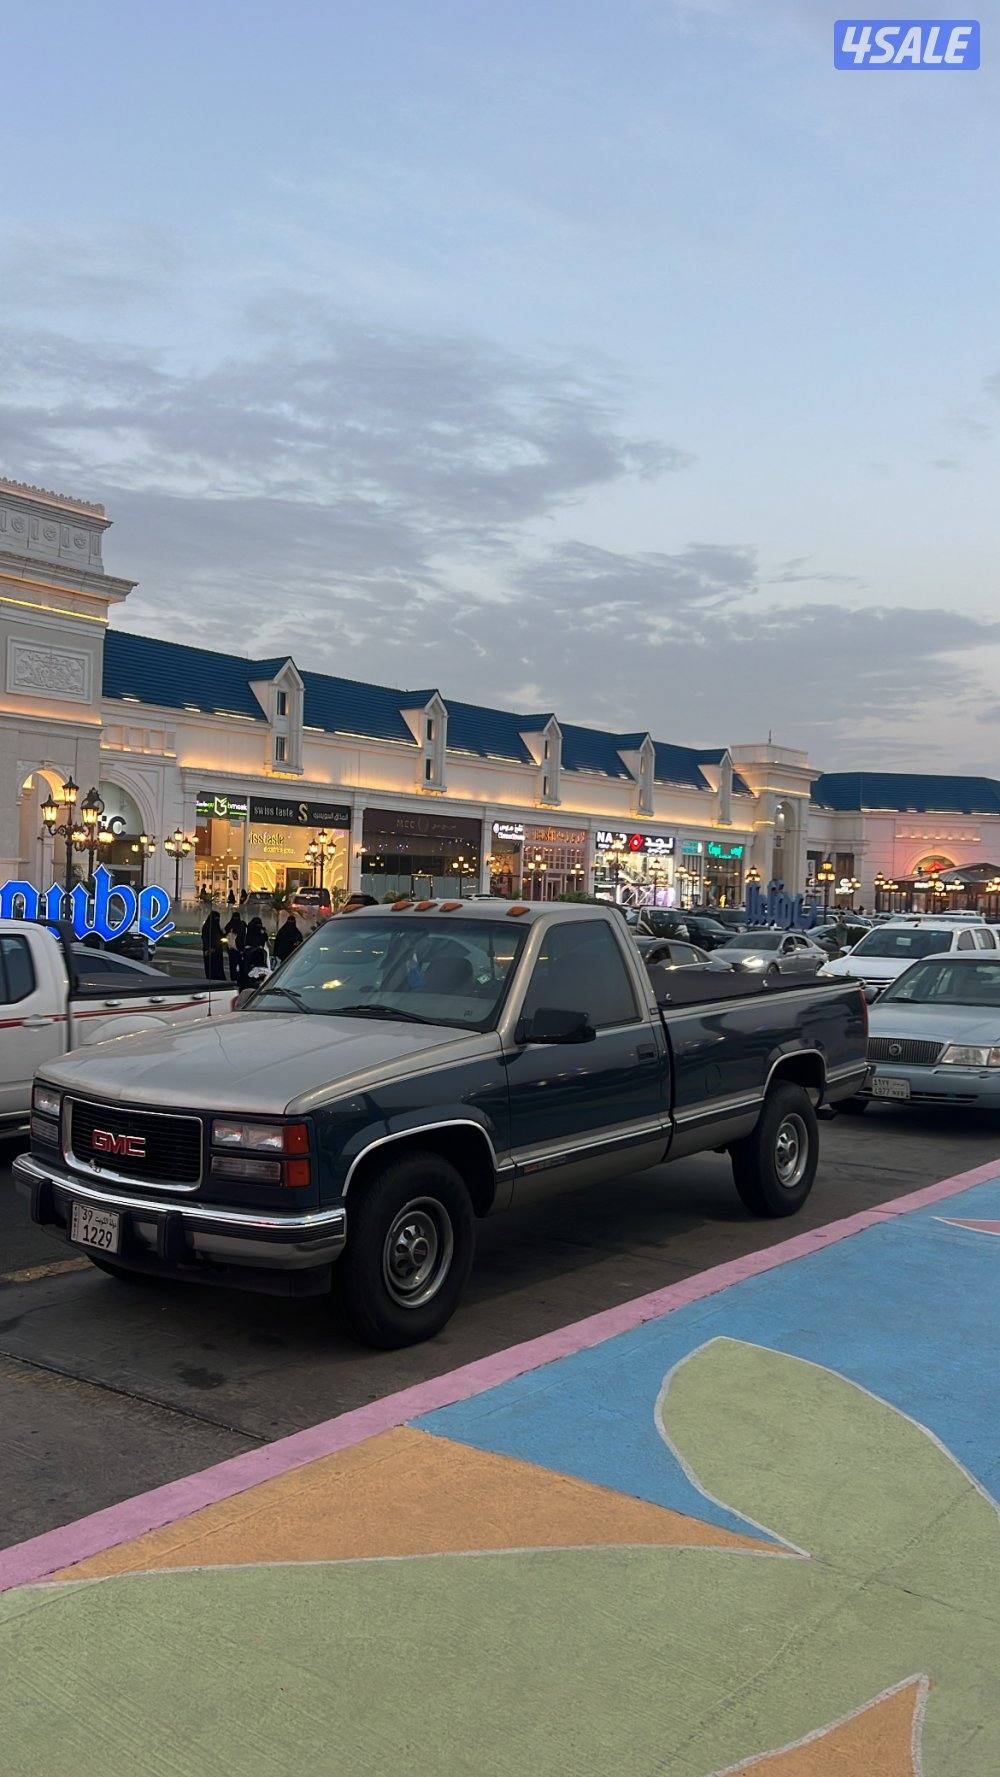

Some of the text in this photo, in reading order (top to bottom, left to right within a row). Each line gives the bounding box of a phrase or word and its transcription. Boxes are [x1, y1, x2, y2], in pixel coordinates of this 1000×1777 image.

[254, 805, 294, 818] swiss taste
[91, 1129, 146, 1157] GMC
[83, 1225, 113, 1248] 1229
